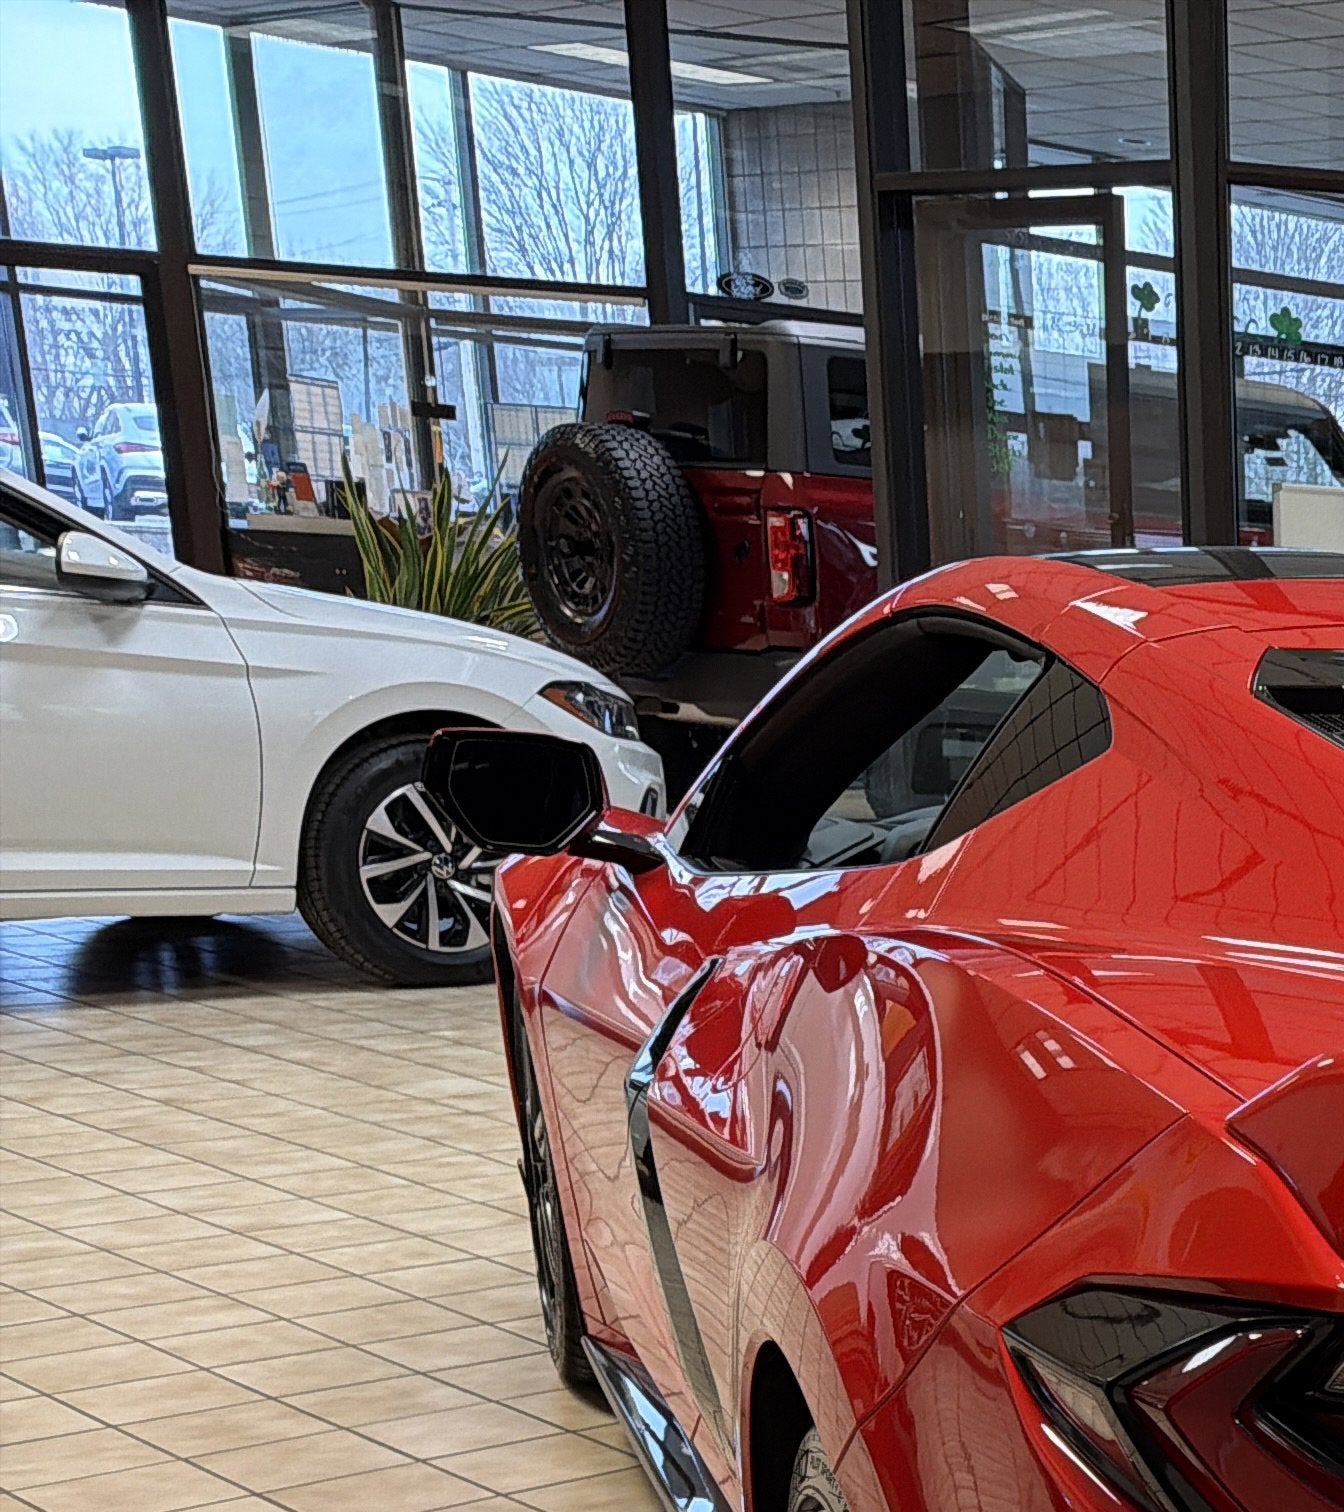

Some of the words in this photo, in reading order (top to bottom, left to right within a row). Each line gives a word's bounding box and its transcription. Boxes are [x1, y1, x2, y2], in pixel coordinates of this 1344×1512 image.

[1267, 346, 1279, 359] 14
[1283, 349, 1296, 361] 15
[1299, 350, 1311, 363] 16
[1317, 353, 1329, 366] 17
